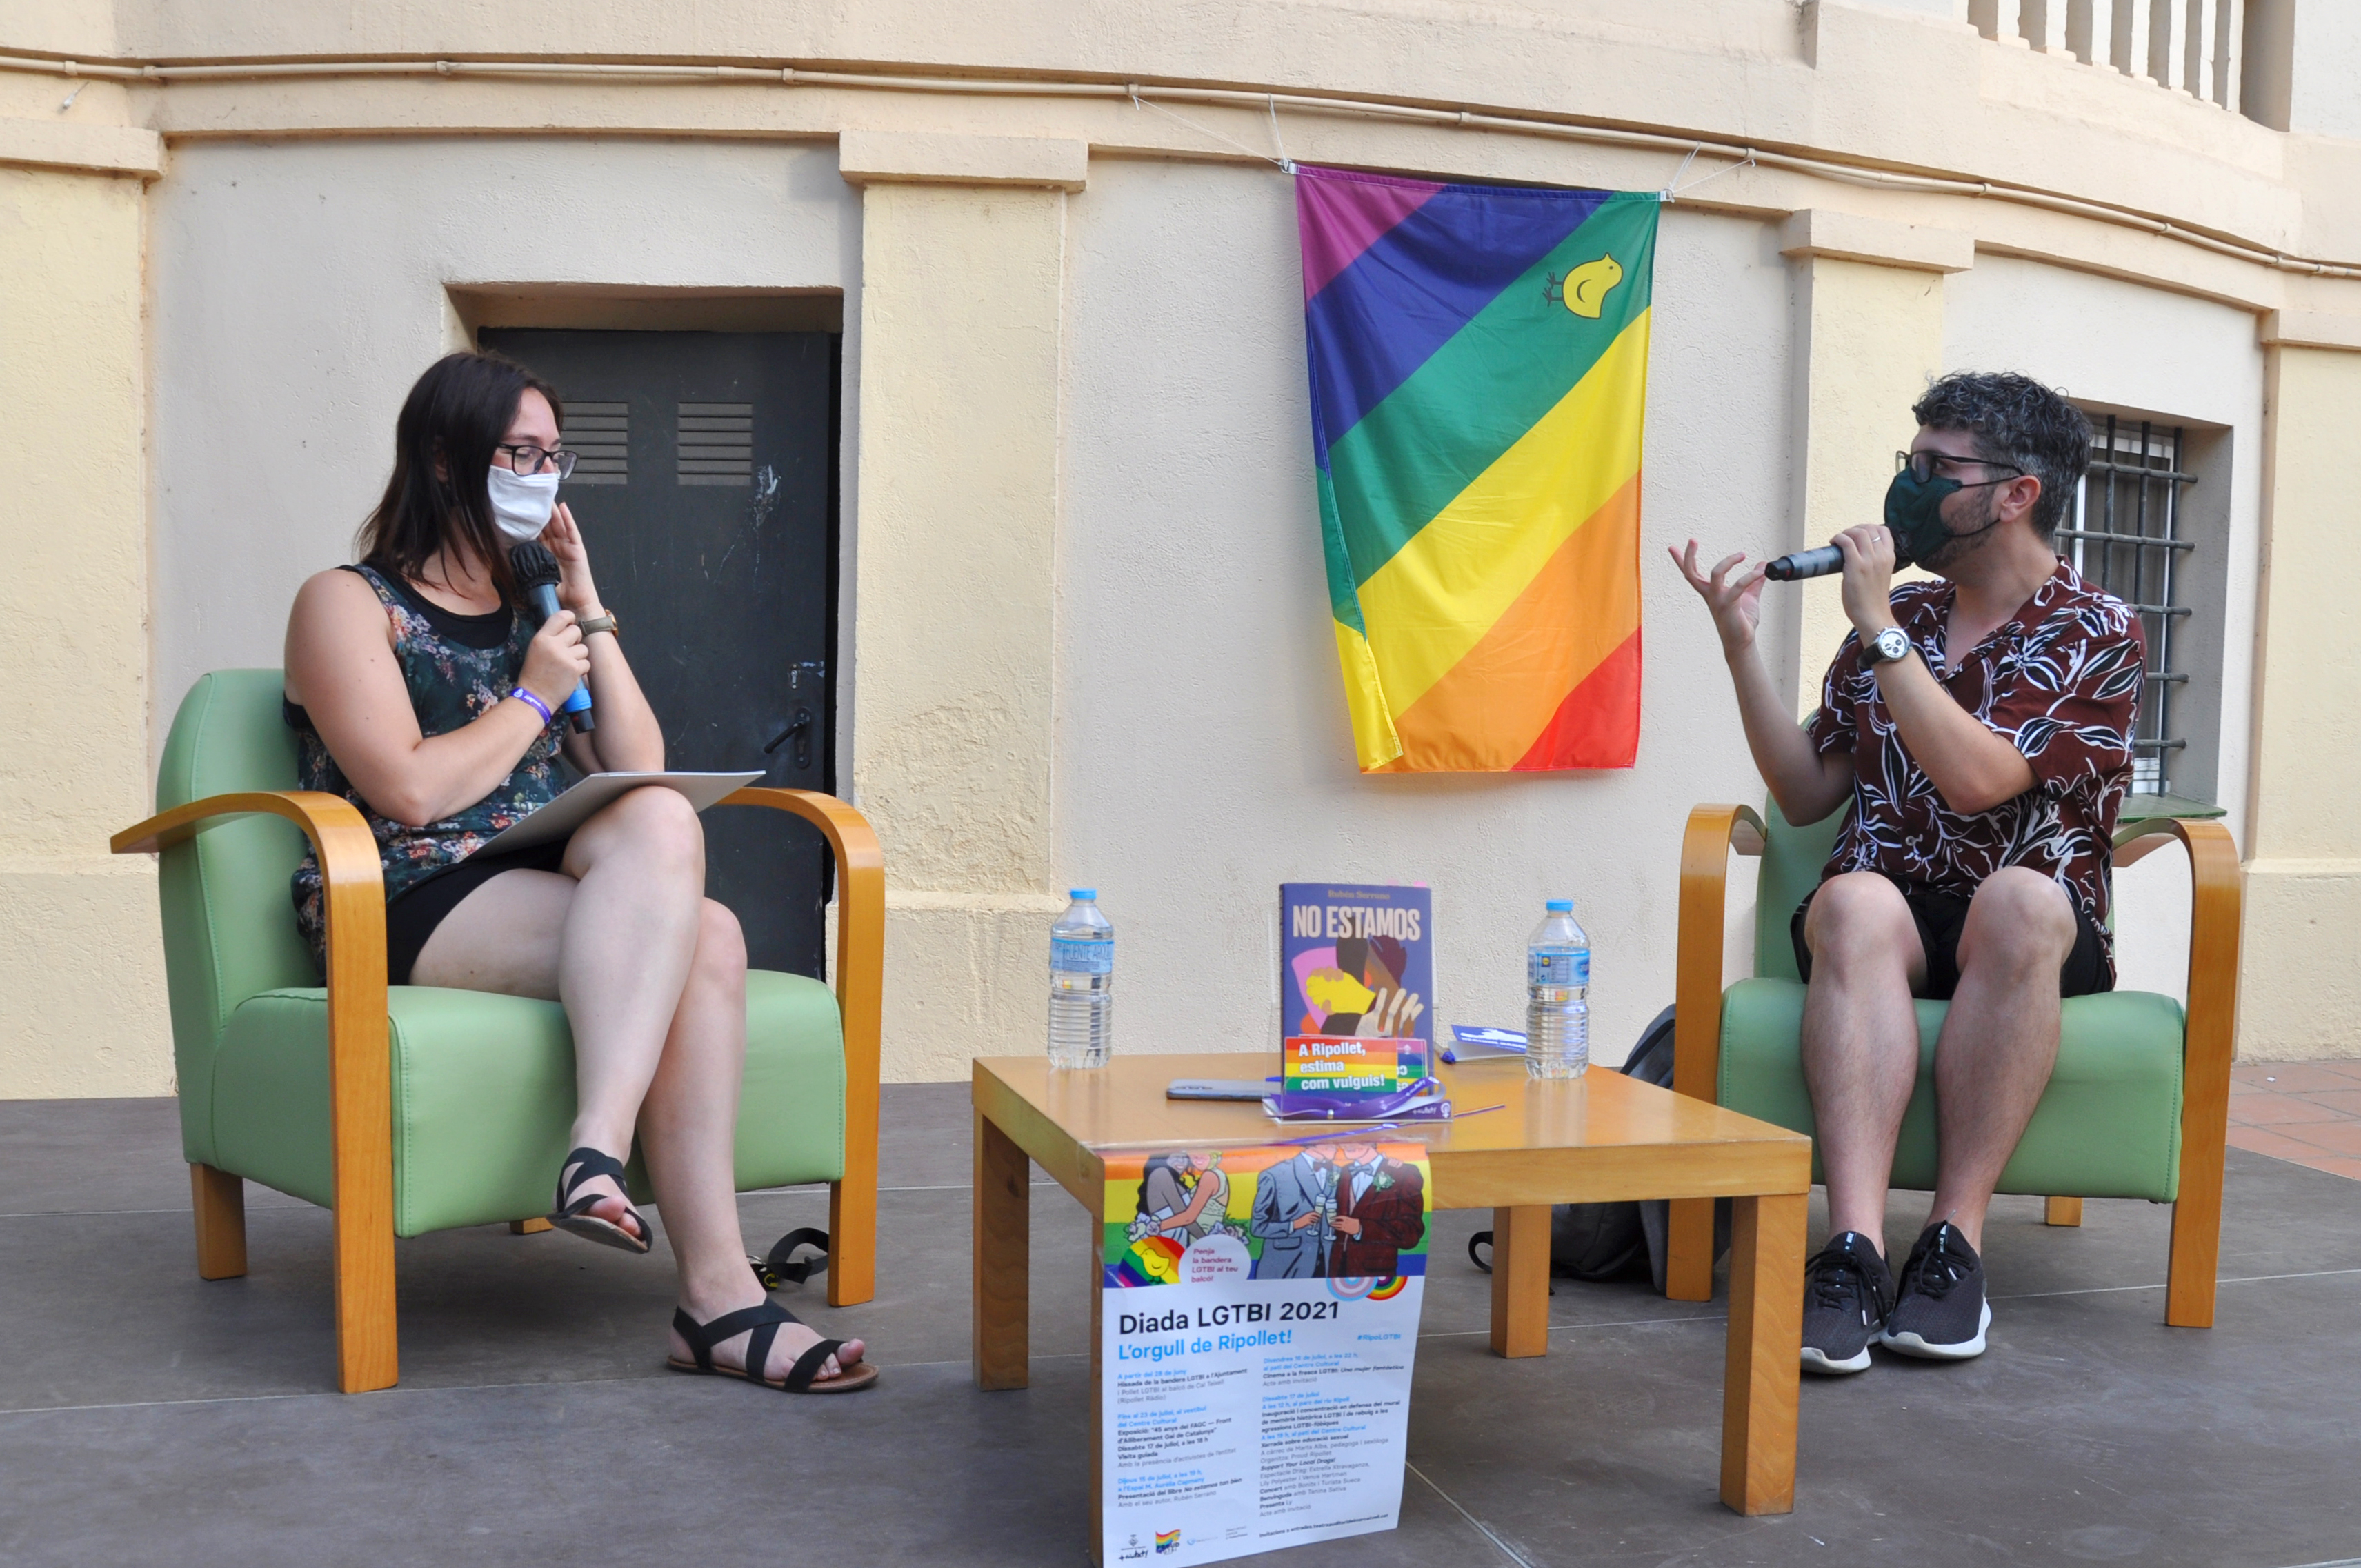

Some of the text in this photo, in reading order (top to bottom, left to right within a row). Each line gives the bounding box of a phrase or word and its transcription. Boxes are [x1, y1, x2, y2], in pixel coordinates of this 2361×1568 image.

[1356, 890, 1391, 900] Serrano
[1293, 905, 1421, 941] NO ESTAMOS
[1299, 1042, 1366, 1058] A Ripollet,
[1299, 1061, 1345, 1073] estima
[1301, 1078, 1331, 1091] com
[1334, 1074, 1385, 1091] vulguis!
[1119, 1301, 1339, 1334] Diada LGTBI 2021
[1119, 1330, 1291, 1362] L'orgull de Ripollet!
[1261, 1463, 1284, 1471] Support
[1118, 1491, 1155, 1500] Presentació
